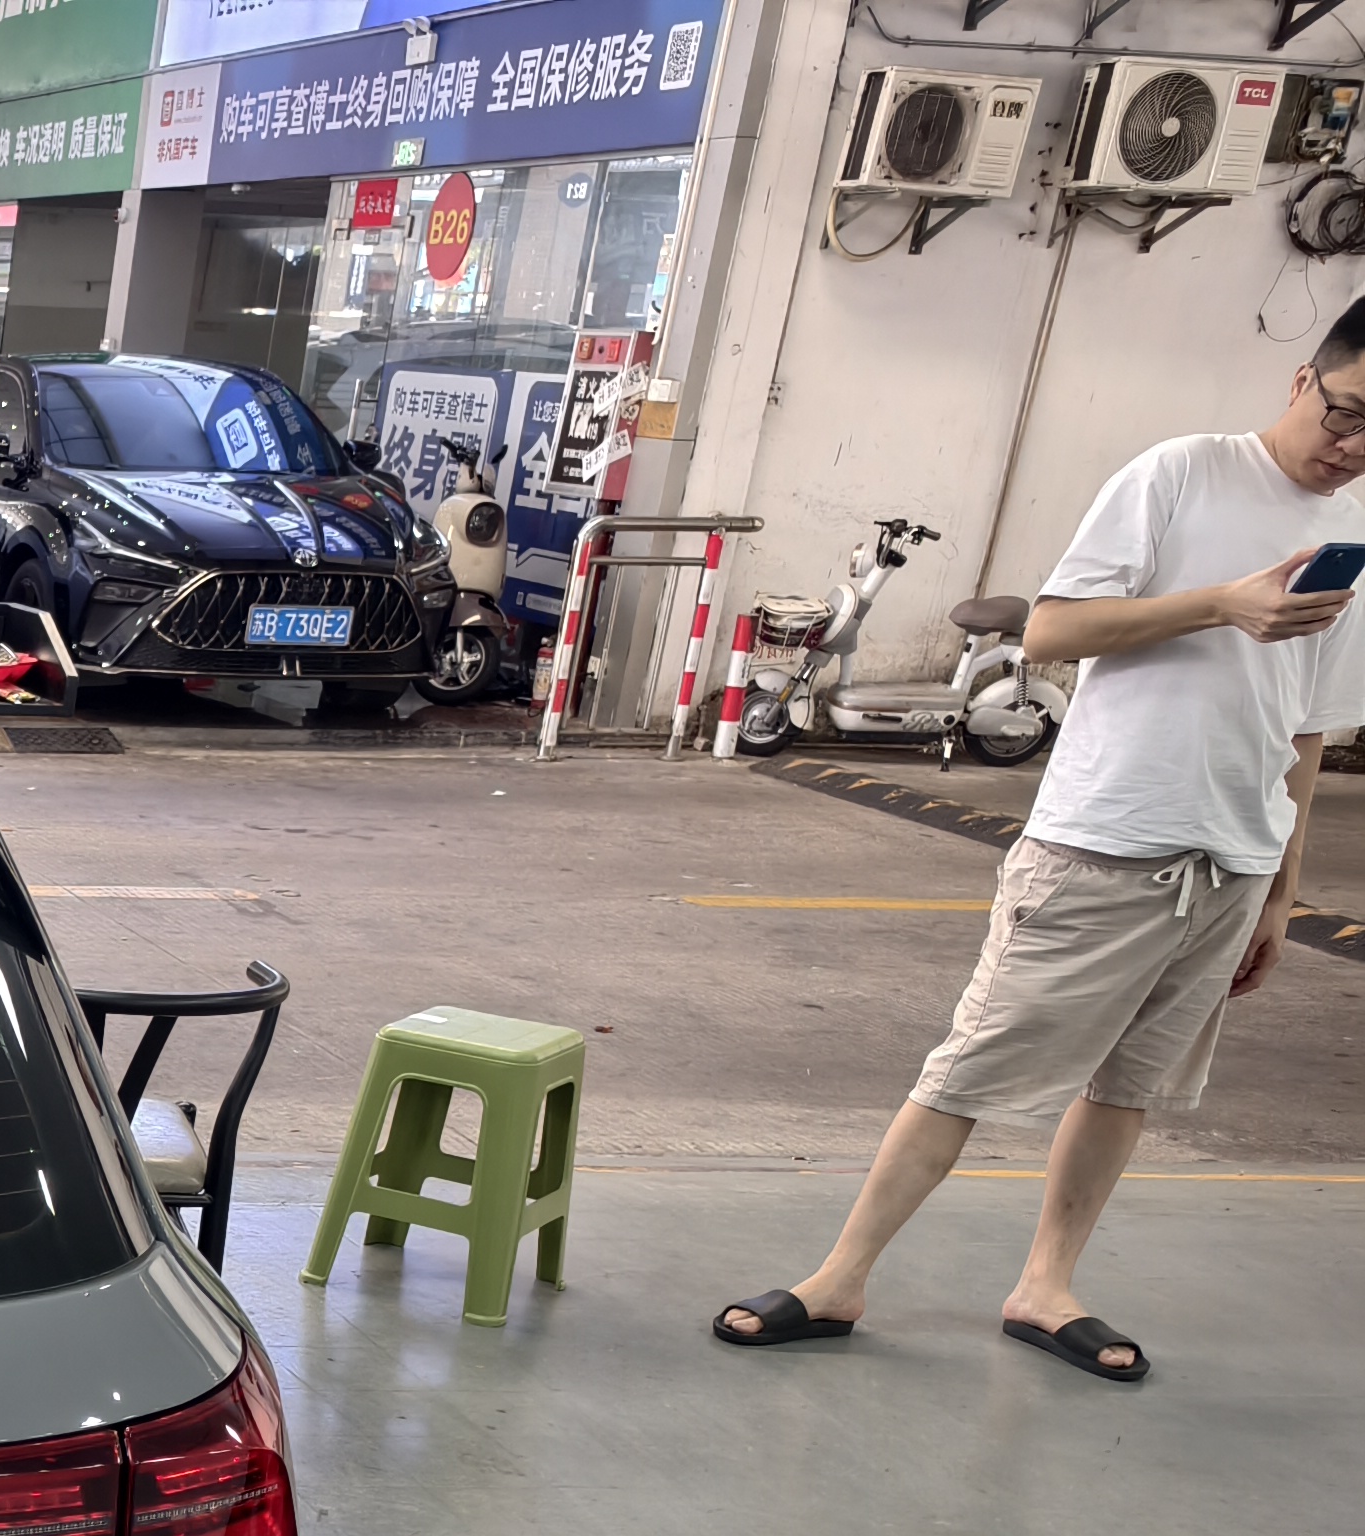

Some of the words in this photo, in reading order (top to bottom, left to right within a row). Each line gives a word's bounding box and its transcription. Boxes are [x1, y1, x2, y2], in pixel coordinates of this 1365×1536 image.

[219, 60, 480, 143] 购车可享查博士终身回购保障
[486, 29, 655, 112] 全国保修服务
[1242, 86, 1269, 100] TCL
[13, 119, 67, 167] 车况透明
[68, 112, 128, 160] 质量保证
[157, 135, 199, 163] 非凡国产车
[429, 208, 471, 246] B26
[392, 386, 488, 424] 购车可享查博士
[383, 423, 444, 500] 终身
